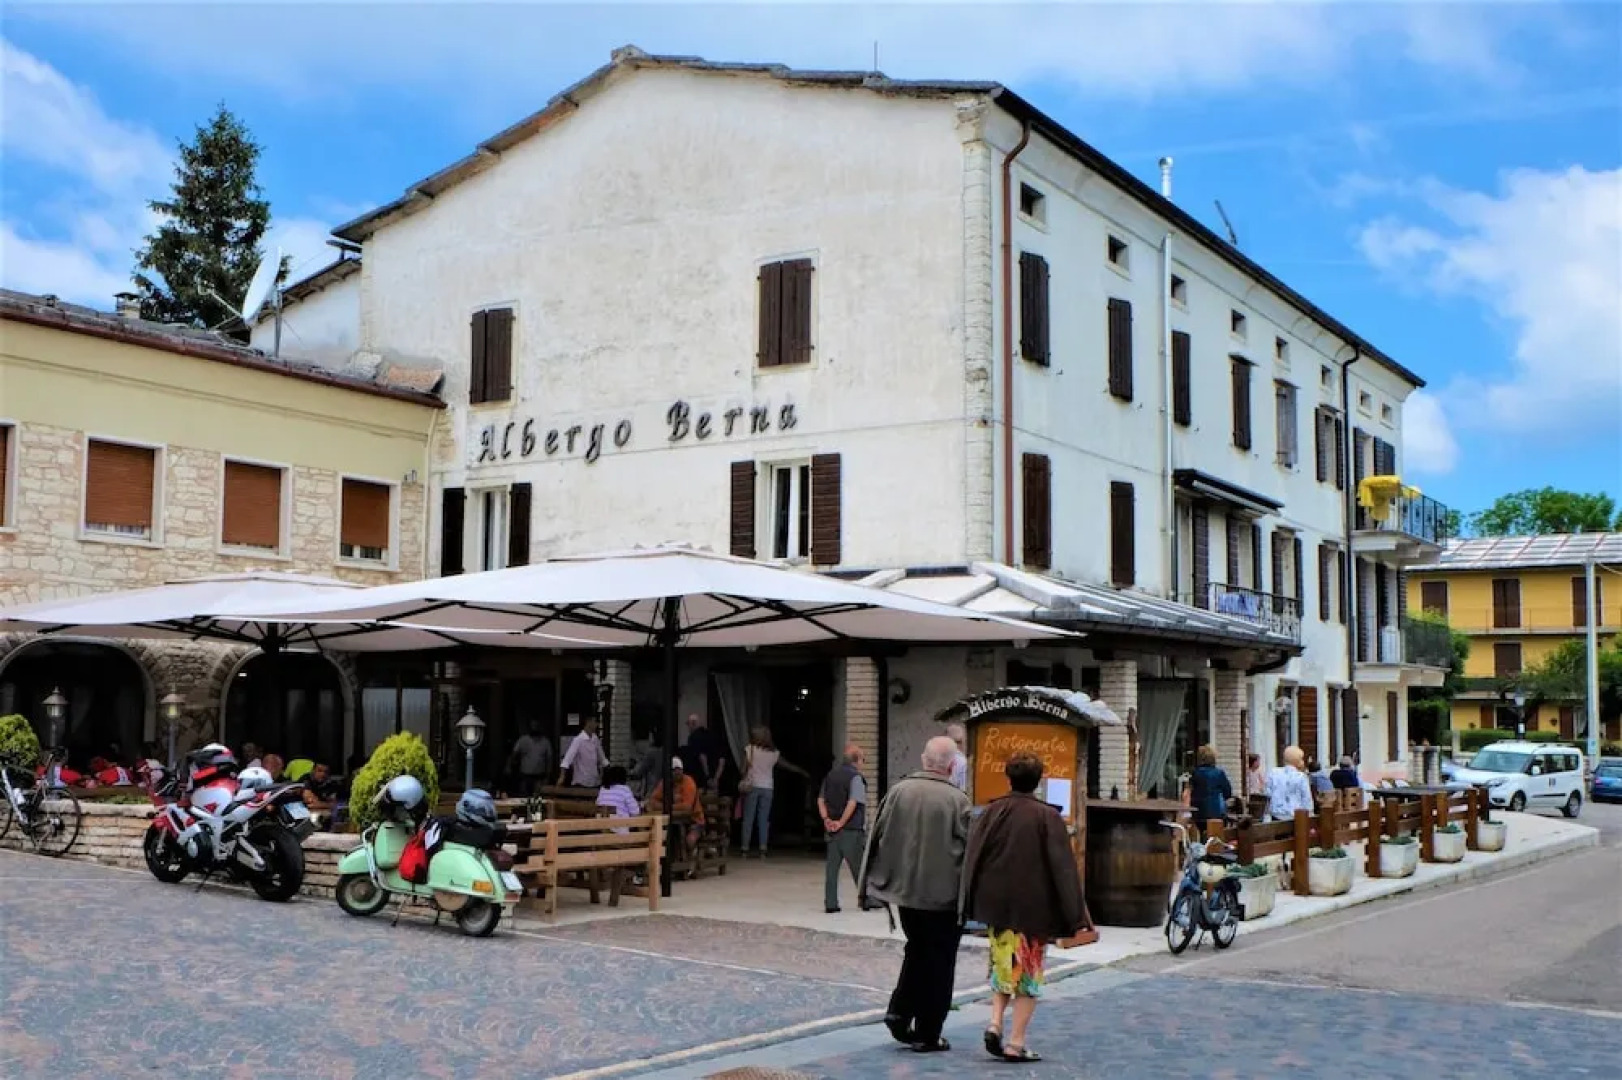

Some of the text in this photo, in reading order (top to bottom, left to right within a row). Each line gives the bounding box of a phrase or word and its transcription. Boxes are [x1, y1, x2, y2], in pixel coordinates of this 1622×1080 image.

[478, 400, 798, 464] Albergo Berna
[969, 693, 1068, 720] Albergo Berna
